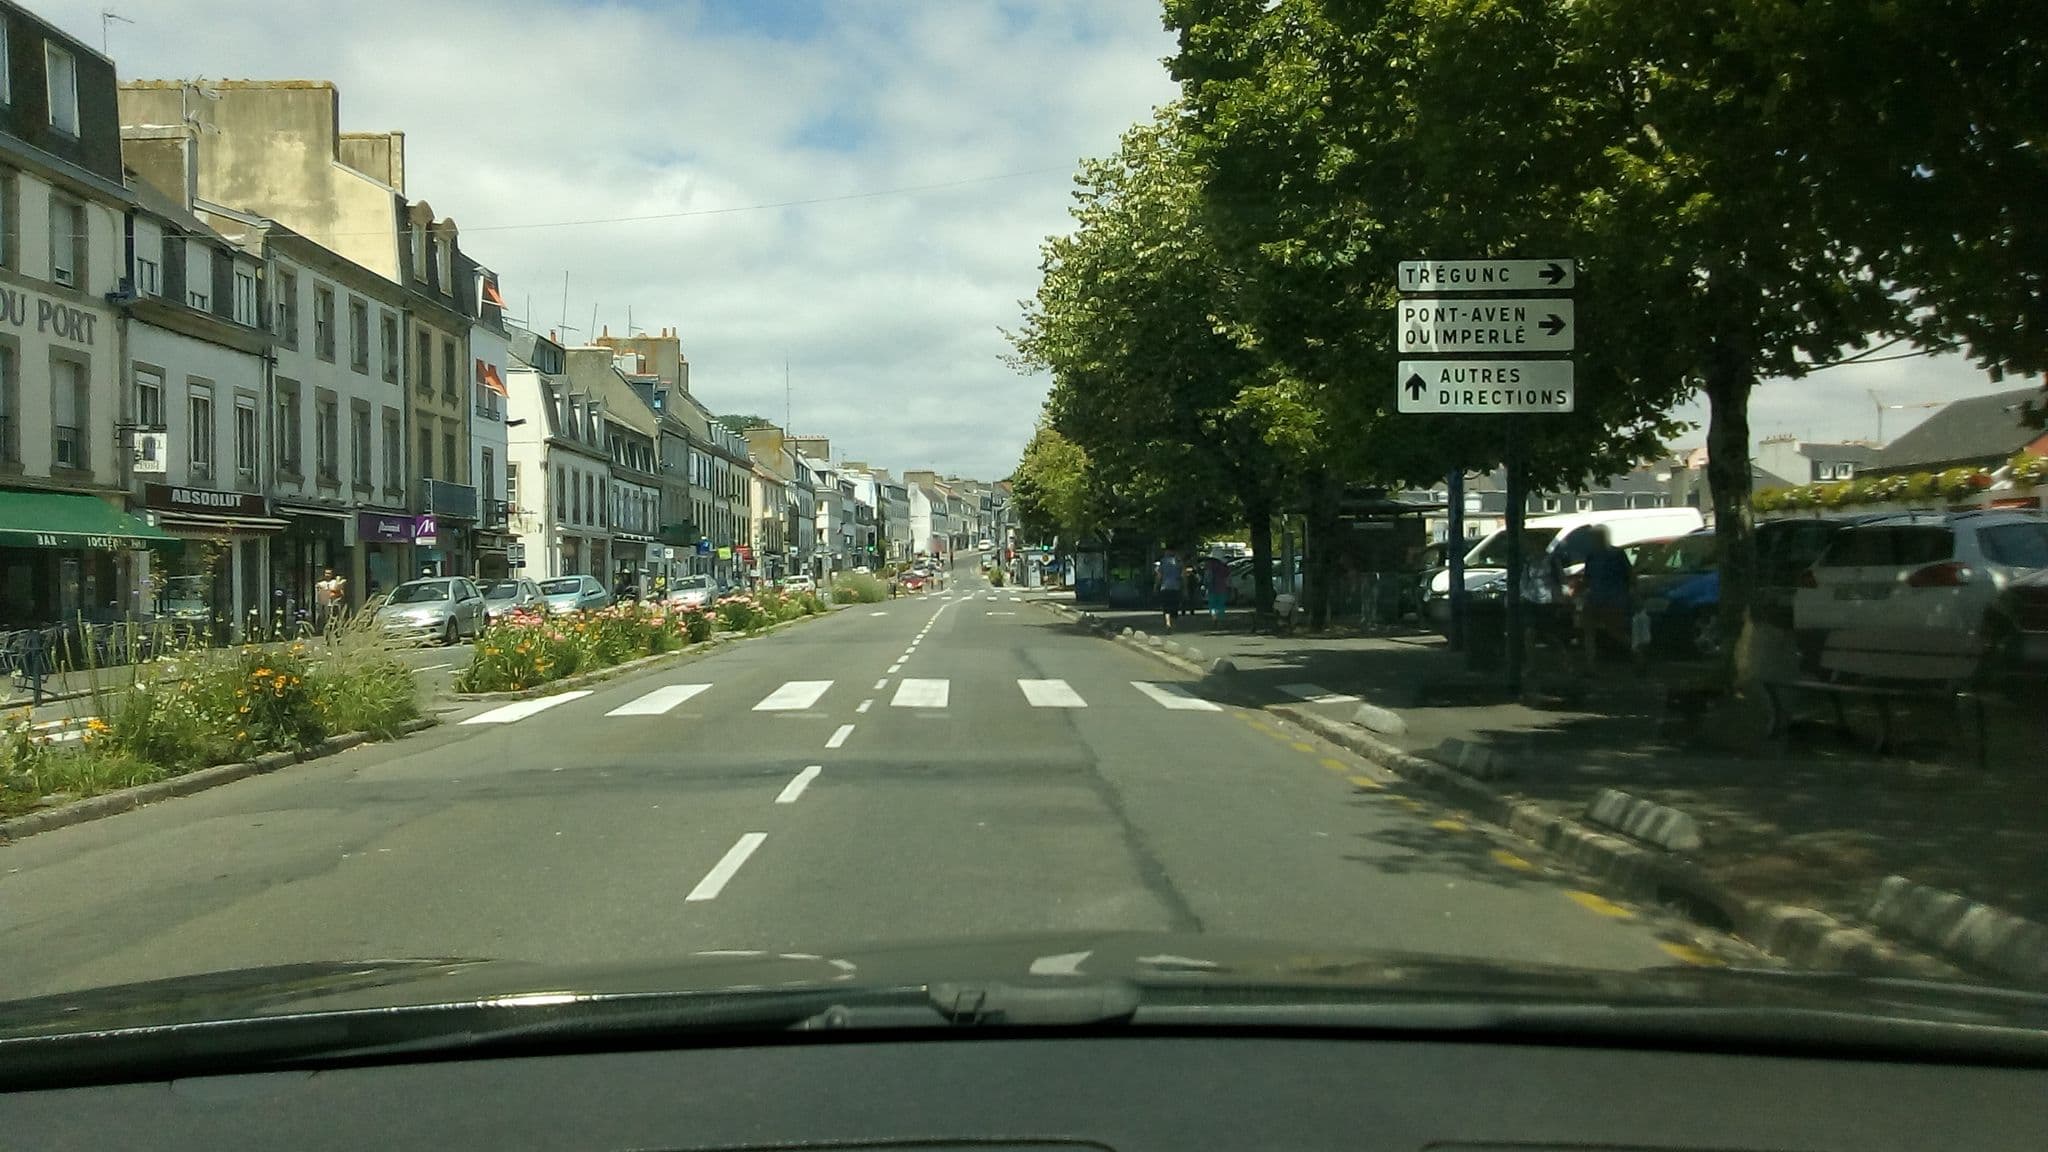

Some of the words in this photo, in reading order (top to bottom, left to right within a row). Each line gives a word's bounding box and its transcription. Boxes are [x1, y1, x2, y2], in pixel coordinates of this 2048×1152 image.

[1405, 265, 1510, 284] TRÉGUNC
[38, 299, 96, 345] PORT
[1405, 307, 1526, 322] PONT-AVEN
[1440, 368, 1521, 383] AUTRES
[1439, 390, 1567, 405] DIRECTIONS
